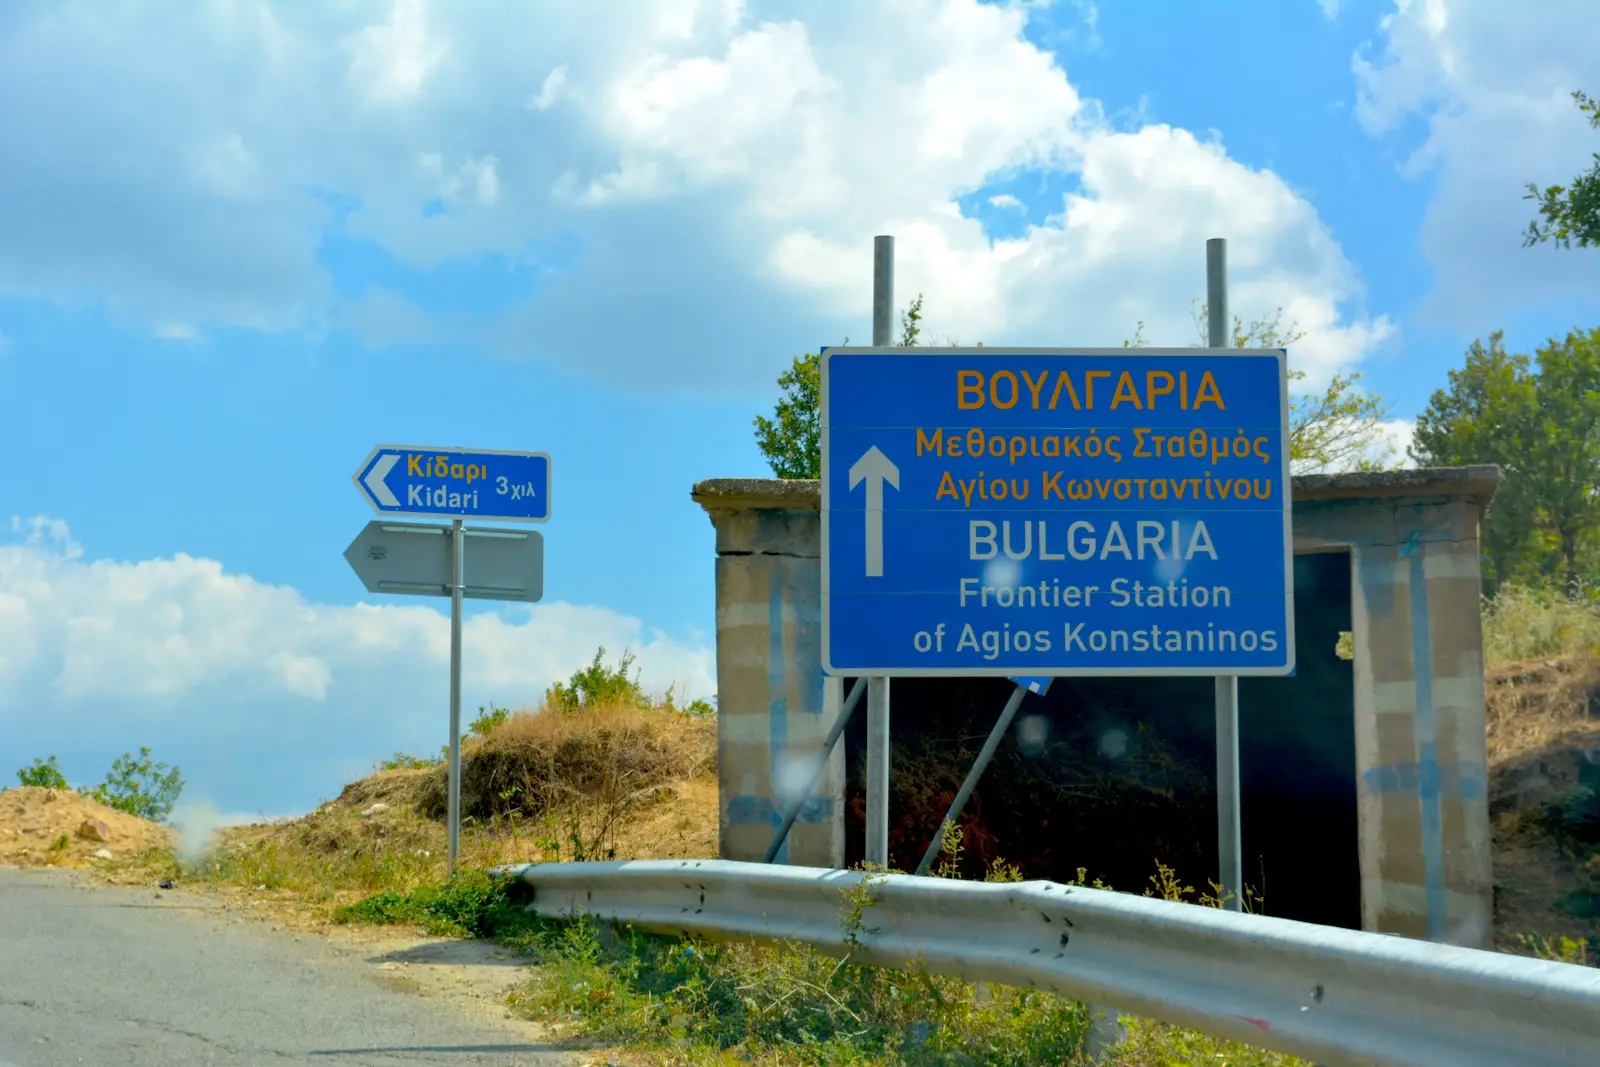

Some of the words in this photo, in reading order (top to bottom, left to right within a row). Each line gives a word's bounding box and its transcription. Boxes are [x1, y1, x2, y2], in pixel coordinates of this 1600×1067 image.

[957, 370, 1226, 410] ΒΟΥΛΓΑΡΙΑ
[915, 427, 1121, 463] Μεθοριακός
[1132, 427, 1270, 464] Σταθμός
[407, 453, 487, 484] Κίδαρι
[407, 484, 478, 509] Kidari
[935, 471, 1029, 508] Αγίου
[1042, 470, 1272, 500] Κωνσταντίνου
[969, 520, 1219, 562] BULGARIA
[959, 577, 1099, 608] Frontier
[1109, 577, 1232, 608] Station
[913, 623, 946, 653] of
[956, 623, 1052, 660] Agios
[1064, 622, 1279, 653] Konstaninos
